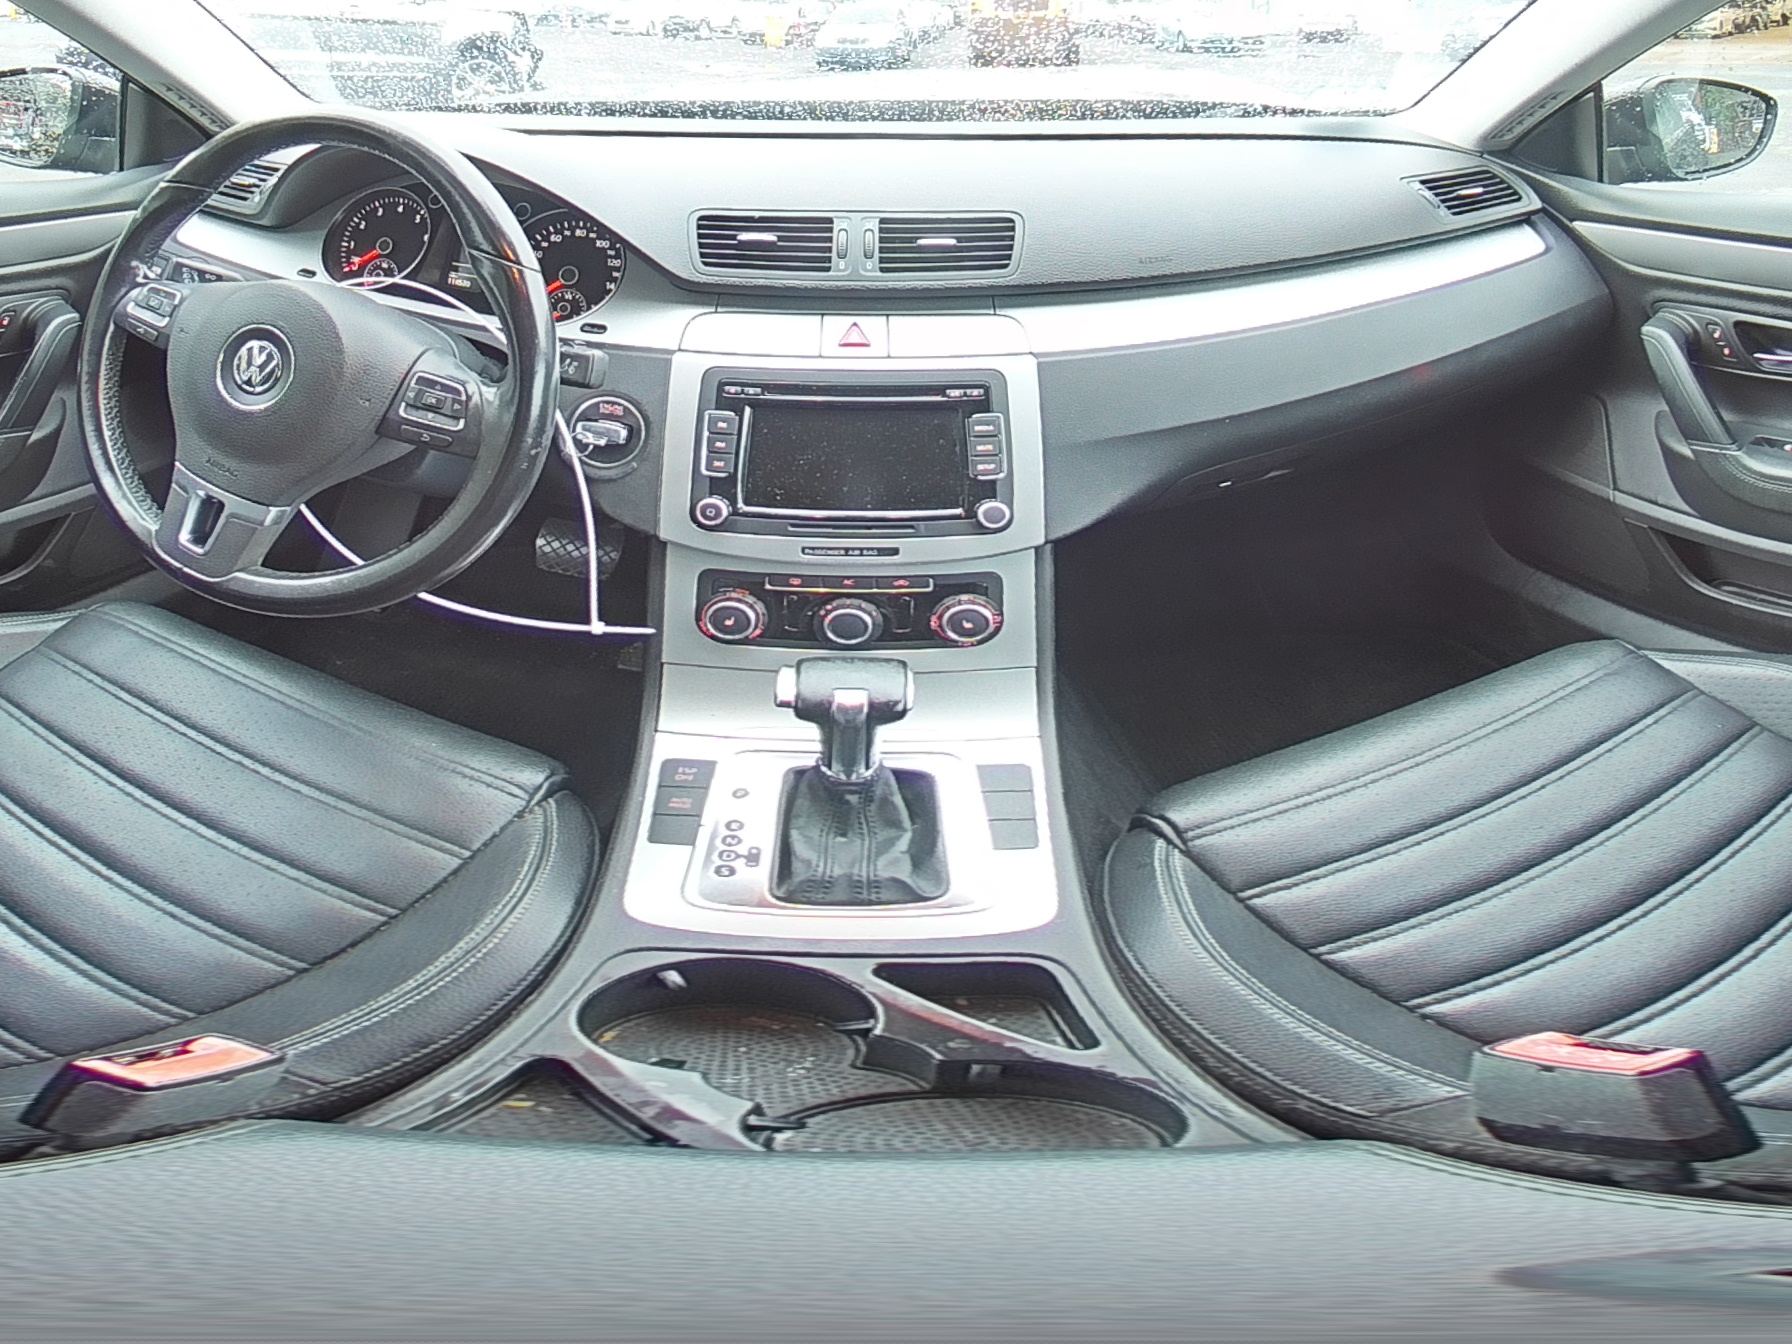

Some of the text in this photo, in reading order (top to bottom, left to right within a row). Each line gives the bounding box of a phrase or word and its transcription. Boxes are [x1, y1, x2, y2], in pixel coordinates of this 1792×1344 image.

[377, 207, 383, 216] 3
[397, 205, 404, 213] 4
[414, 214, 421, 223] 5
[359, 220, 366, 229] 2
[575, 229, 586, 237] 80
[350, 240, 355, 249] 1
[596, 240, 610, 248] 100
[608, 258, 621, 266] 120
